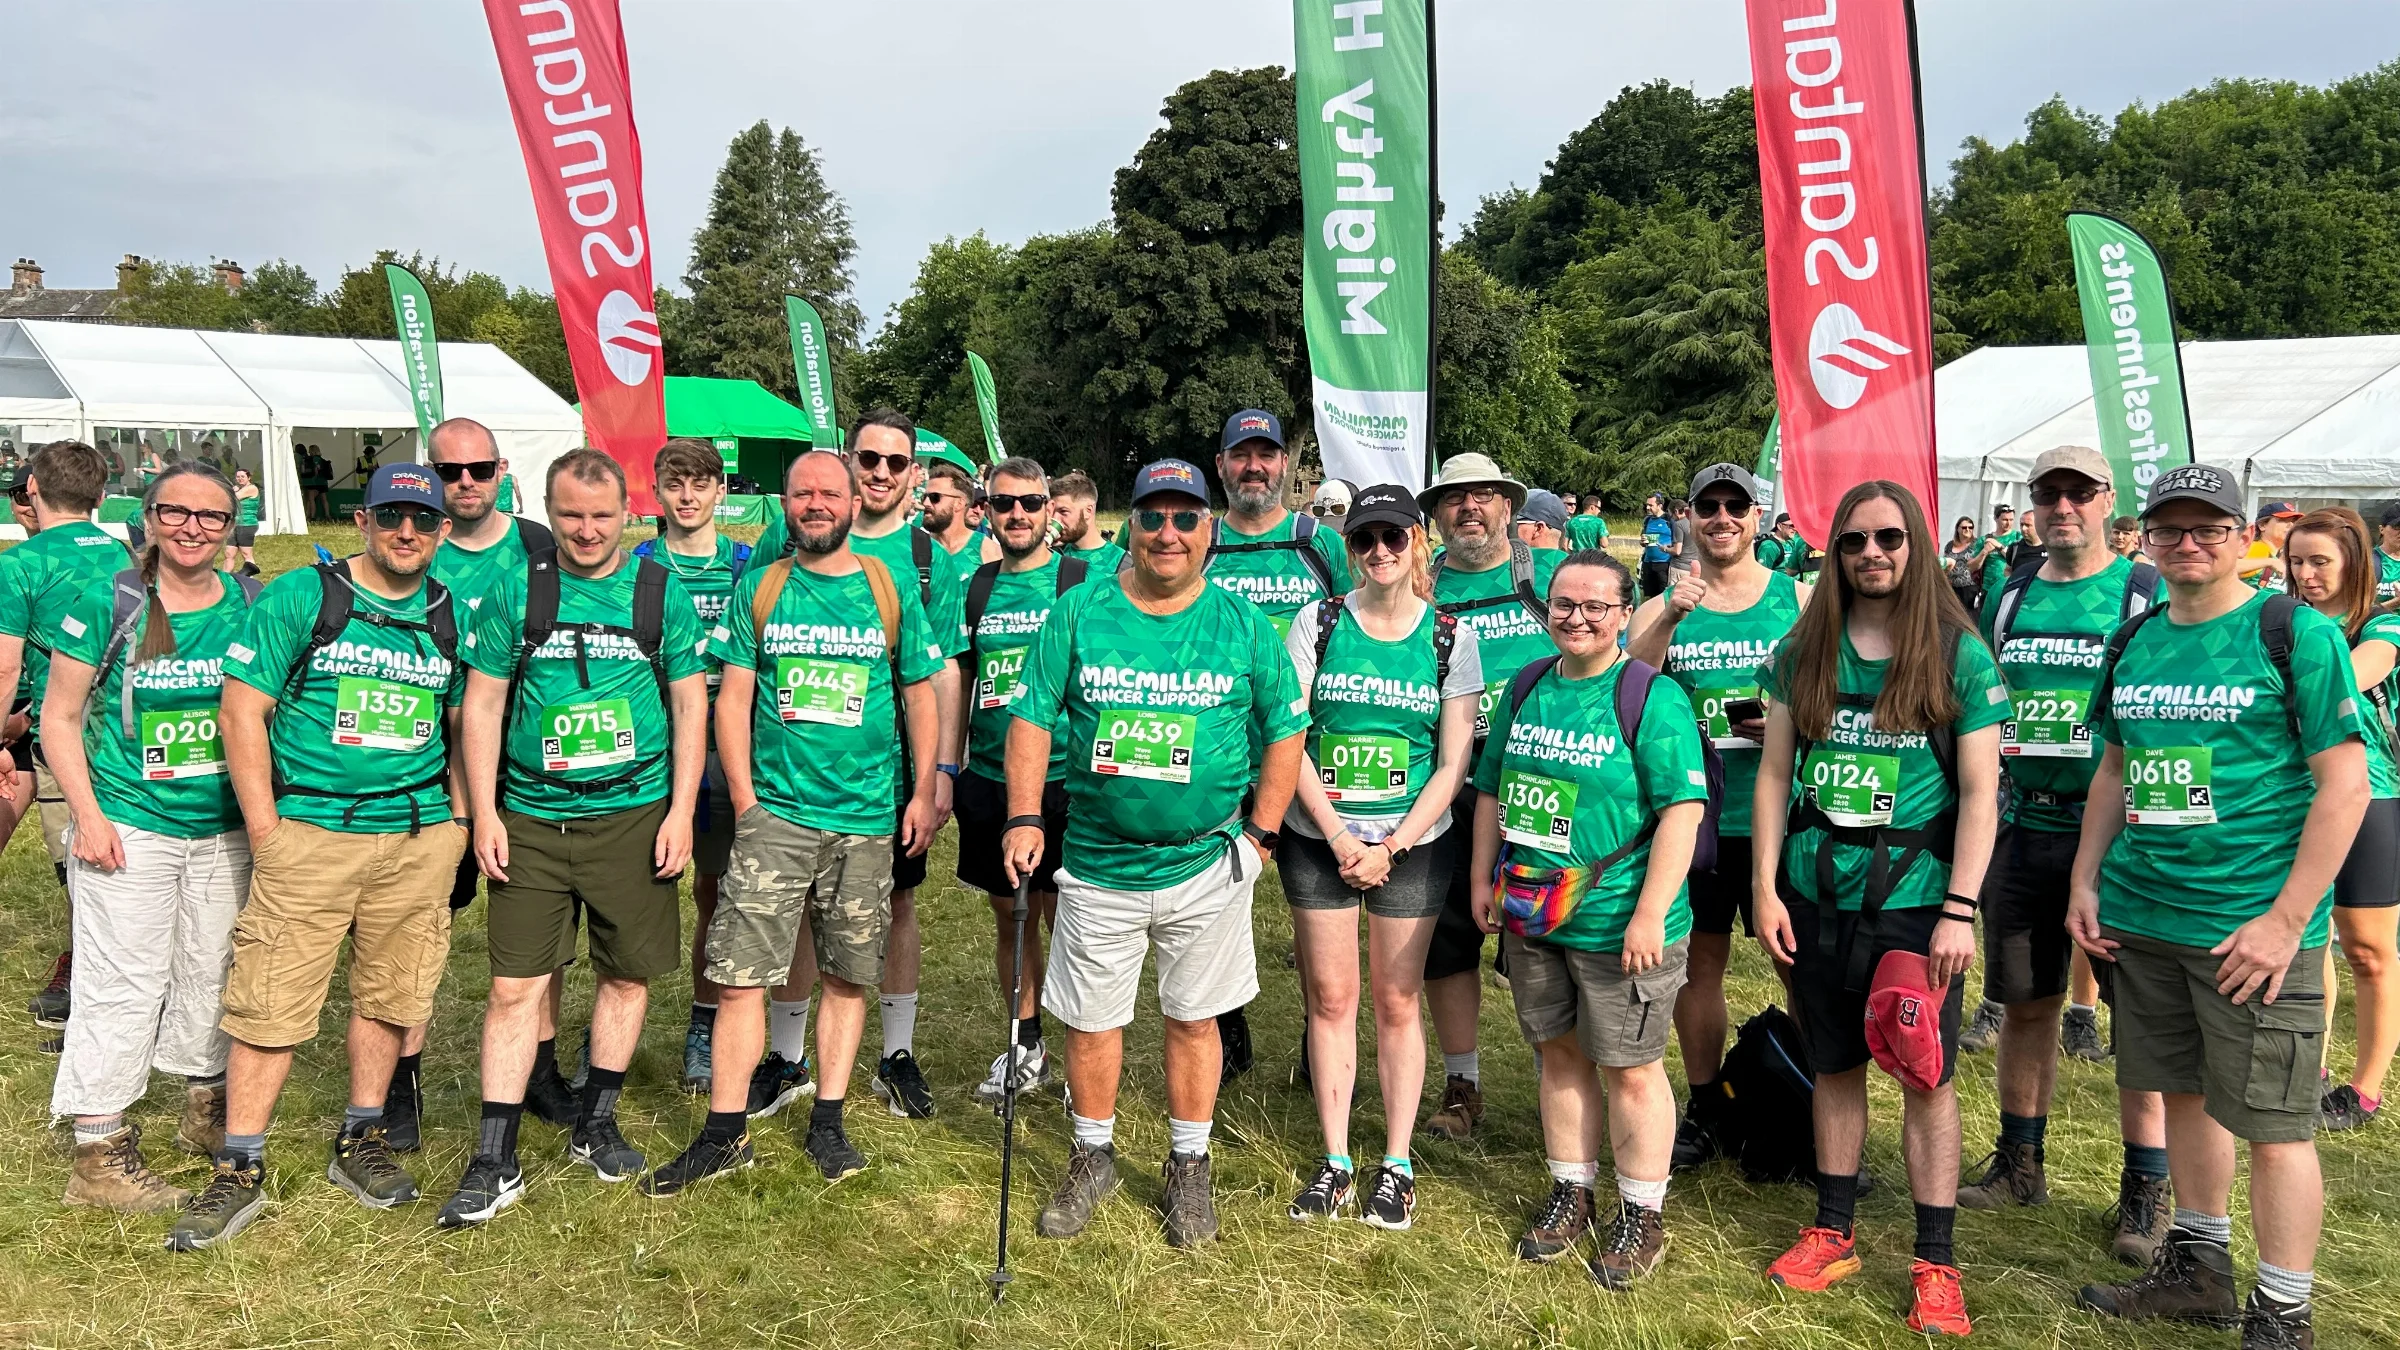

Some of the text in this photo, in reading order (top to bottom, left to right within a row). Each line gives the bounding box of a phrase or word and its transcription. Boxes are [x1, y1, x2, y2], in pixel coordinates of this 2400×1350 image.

[716, 440, 736, 450] INFO
[392, 472, 431, 484] ORACLE
[1150, 462, 1192, 473] ORACLE
[2159, 468, 2219, 483] STAR
[390, 485, 432, 495] RACING
[2157, 477, 2222, 495] WARS
[763, 623, 887, 646] MACMILLAN
[1483, 623, 1543, 640] SUPPORT
[313, 640, 452, 676] MACMILLAN
[763, 641, 884, 659] CANCER SUPPORT
[313, 658, 447, 689] CANCER SUPPORT
[1670, 657, 1722, 673] CANCER
[132, 675, 199, 690] CANCER
[787, 667, 857, 693] 0445
[1079, 665, 1234, 695] MACMILLAN
[1317, 672, 1440, 704] MACMILLAN
[356, 689, 420, 718] 1357
[1082, 687, 1223, 708] CANCER SUPPORT
[1317, 690, 1436, 715] CANCER SUPPORT
[2033, 690, 2056, 698] SIMON
[2111, 684, 2256, 708] MACMILLAN
[182, 710, 211, 719] ALISON
[2015, 699, 2078, 722] 1222
[2158, 707, 2242, 723] SUPPORT
[155, 718, 224, 745] 020
[553, 709, 618, 737] 0715
[1109, 719, 1183, 745] 0439
[1348, 736, 1378, 744] HARRIET
[1332, 745, 1394, 768] 0175
[1532, 744, 1606, 769] SUPPORT
[1833, 753, 1857, 762] JAMES
[2145, 749, 2165, 757] DAVE
[1813, 761, 1882, 791] 0124
[2129, 758, 2194, 785] 0618
[1506, 782, 1560, 814] 1306
